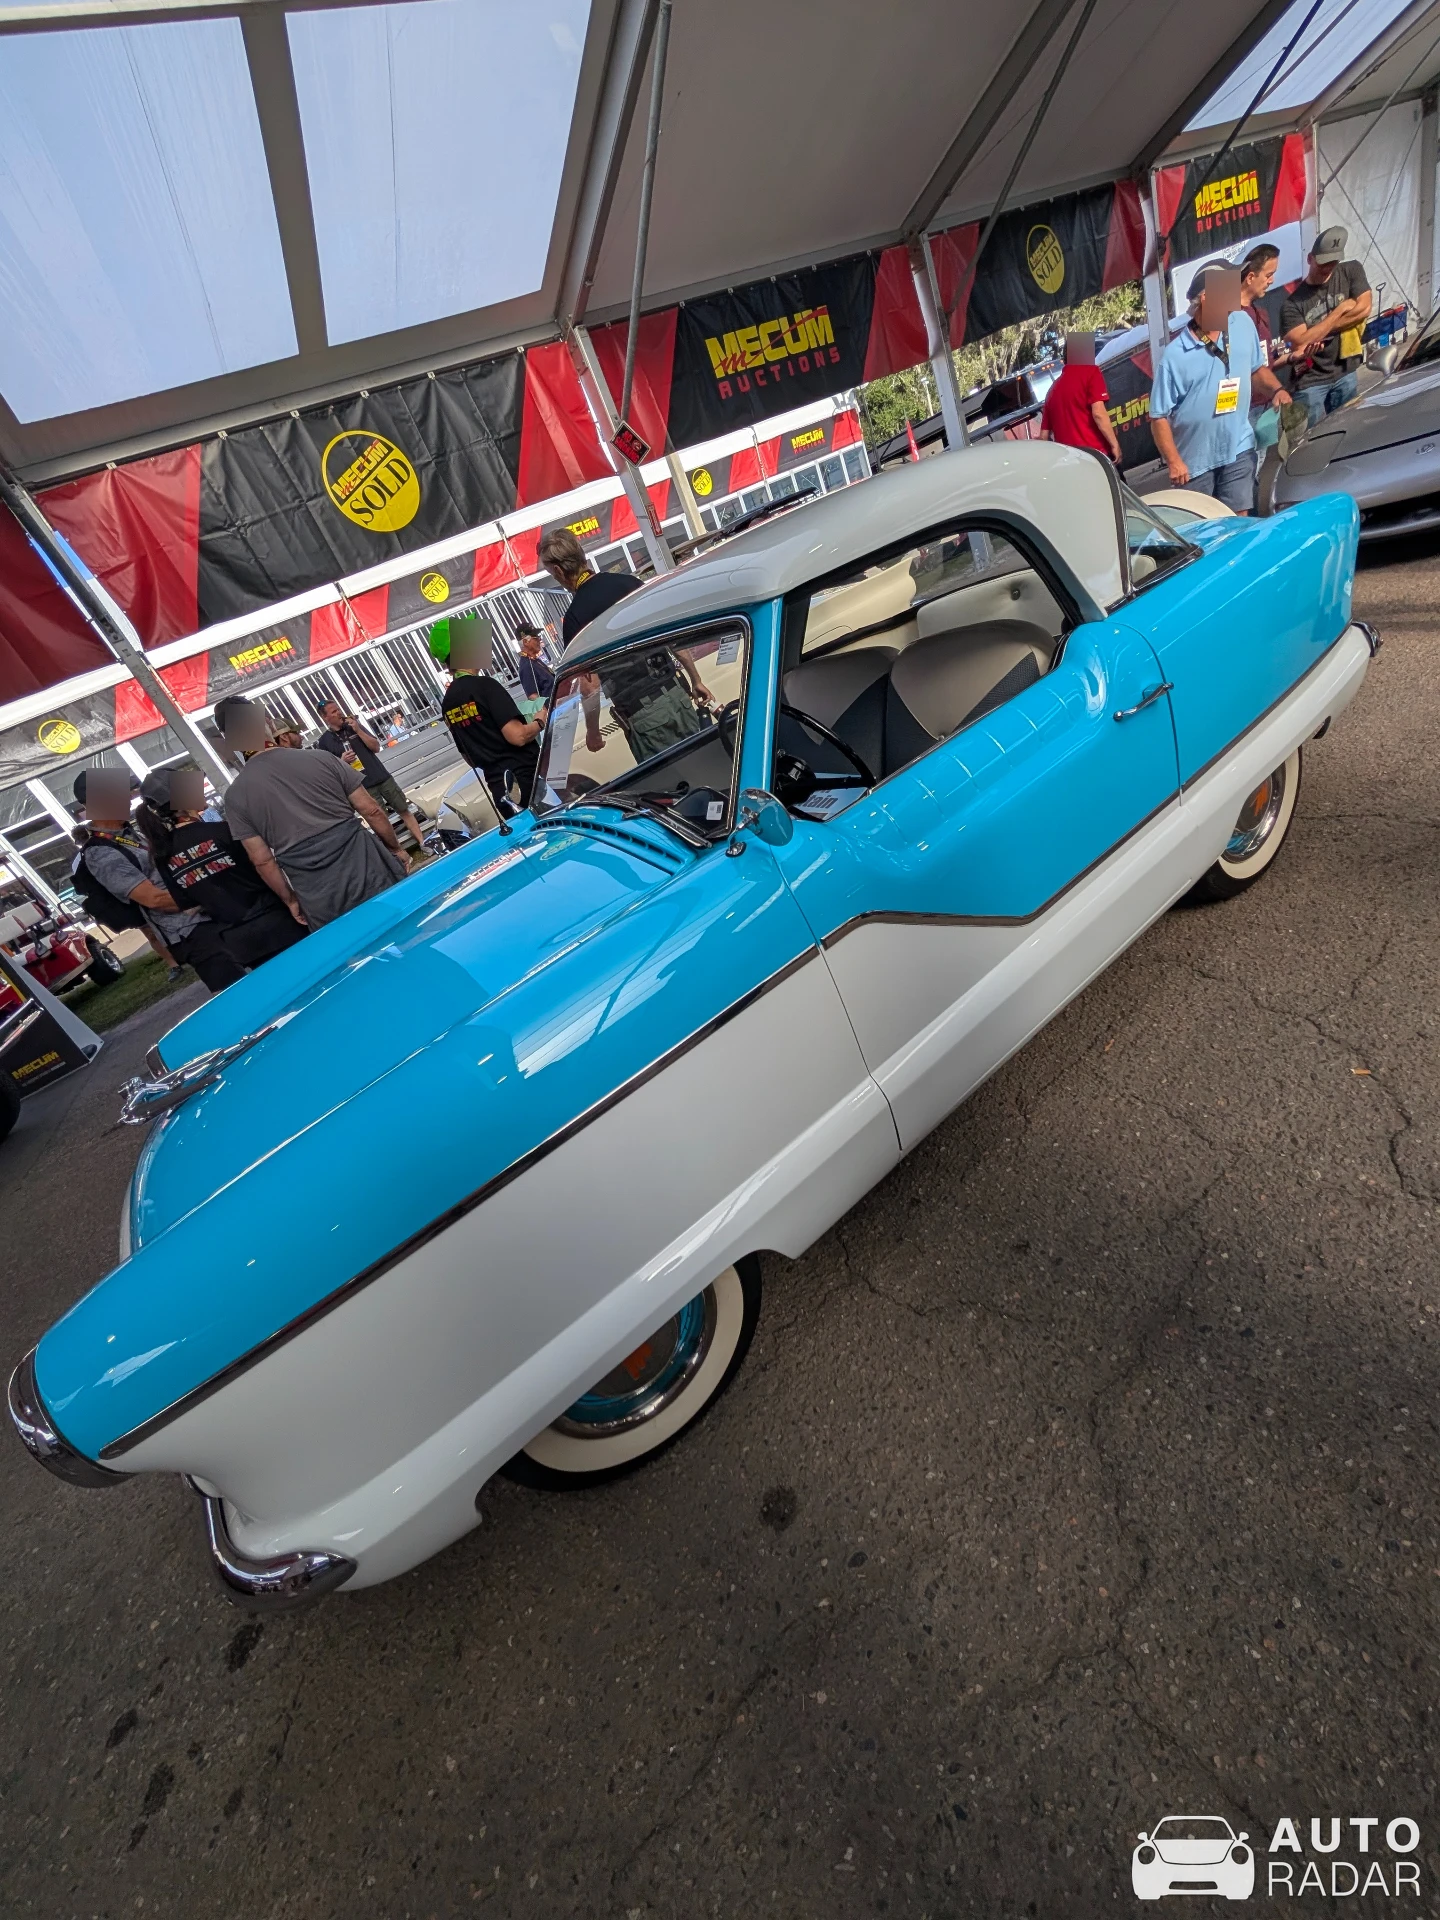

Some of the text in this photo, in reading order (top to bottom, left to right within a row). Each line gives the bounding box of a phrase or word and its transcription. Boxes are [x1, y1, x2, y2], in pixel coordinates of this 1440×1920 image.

[1195, 170, 1258, 218] MECUM
[1197, 200, 1260, 233] AUCTIONS
[1030, 232, 1054, 268] MECUM
[1036, 246, 1061, 286] SOLD
[705, 305, 835, 378] MECUM
[718, 346, 840, 400] AUCTIONS
[614, 436, 640, 463] SMOKING
[792, 428, 823, 450] MECUM
[332, 439, 389, 500] MECUM
[697, 476, 711, 493] SOLD
[350, 458, 411, 525] SOLD
[428, 581, 446, 600] SOLD
[229, 636, 292, 671] MECUM
[236, 648, 297, 677] AUCTIONS
[51, 727, 76, 752] SOLD
[187, 839, 218, 860] HERE
[12, 1051, 59, 1079] MECUM
